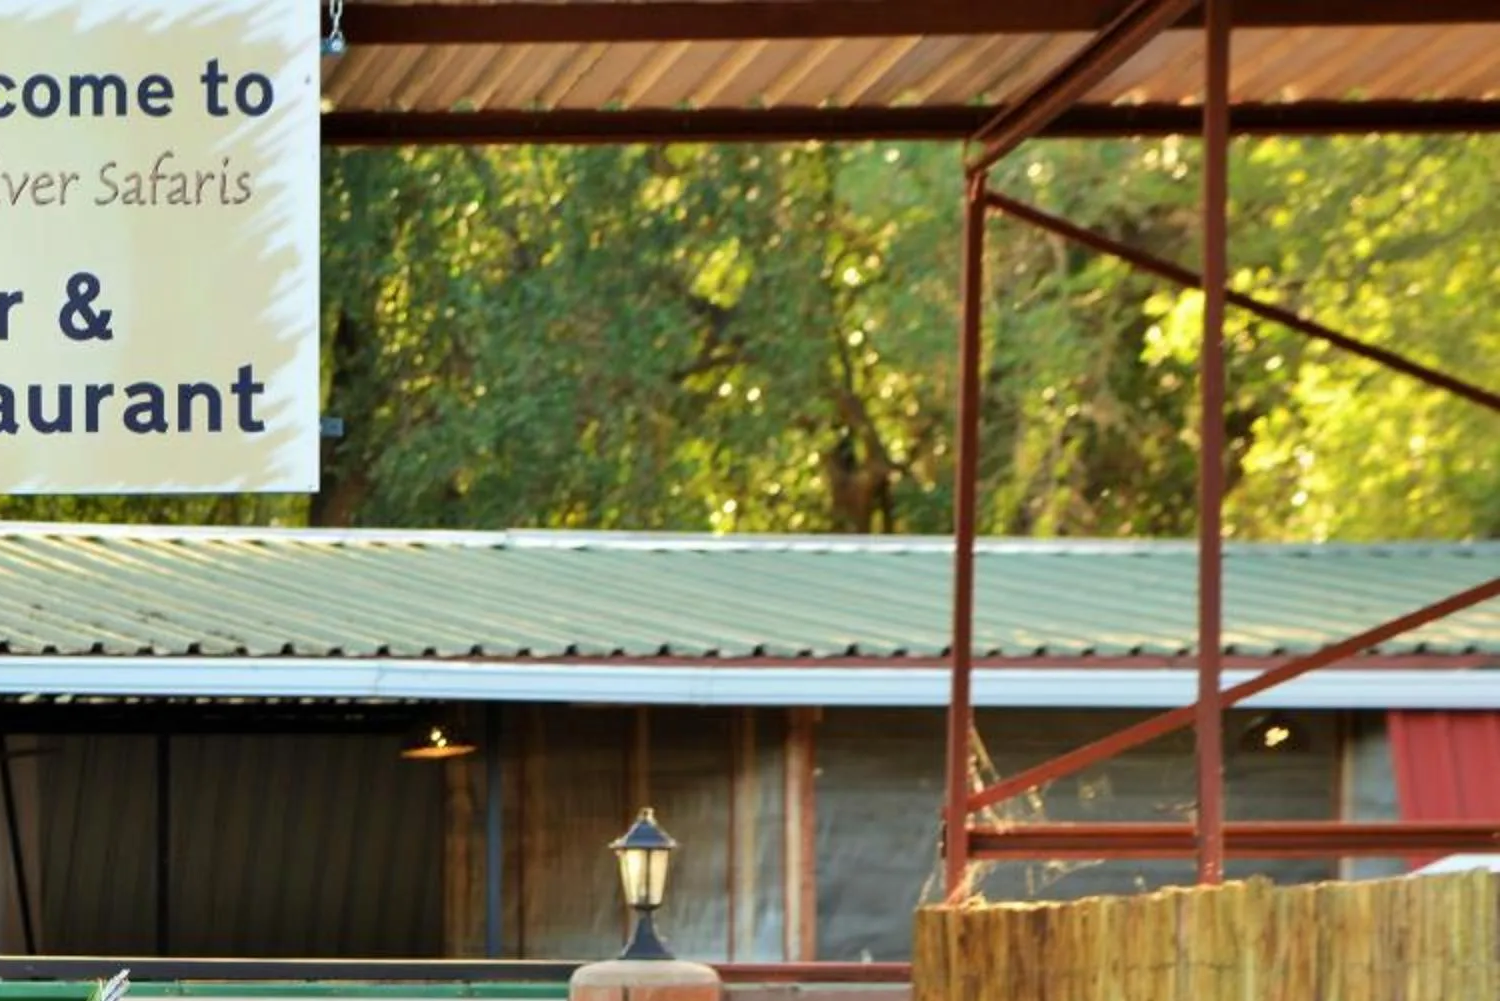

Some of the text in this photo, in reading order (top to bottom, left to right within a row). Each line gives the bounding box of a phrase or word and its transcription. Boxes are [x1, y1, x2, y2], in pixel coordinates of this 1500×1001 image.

[200, 58, 274, 117] to
[95, 150, 252, 207] Safaris
[58, 272, 114, 342] &
